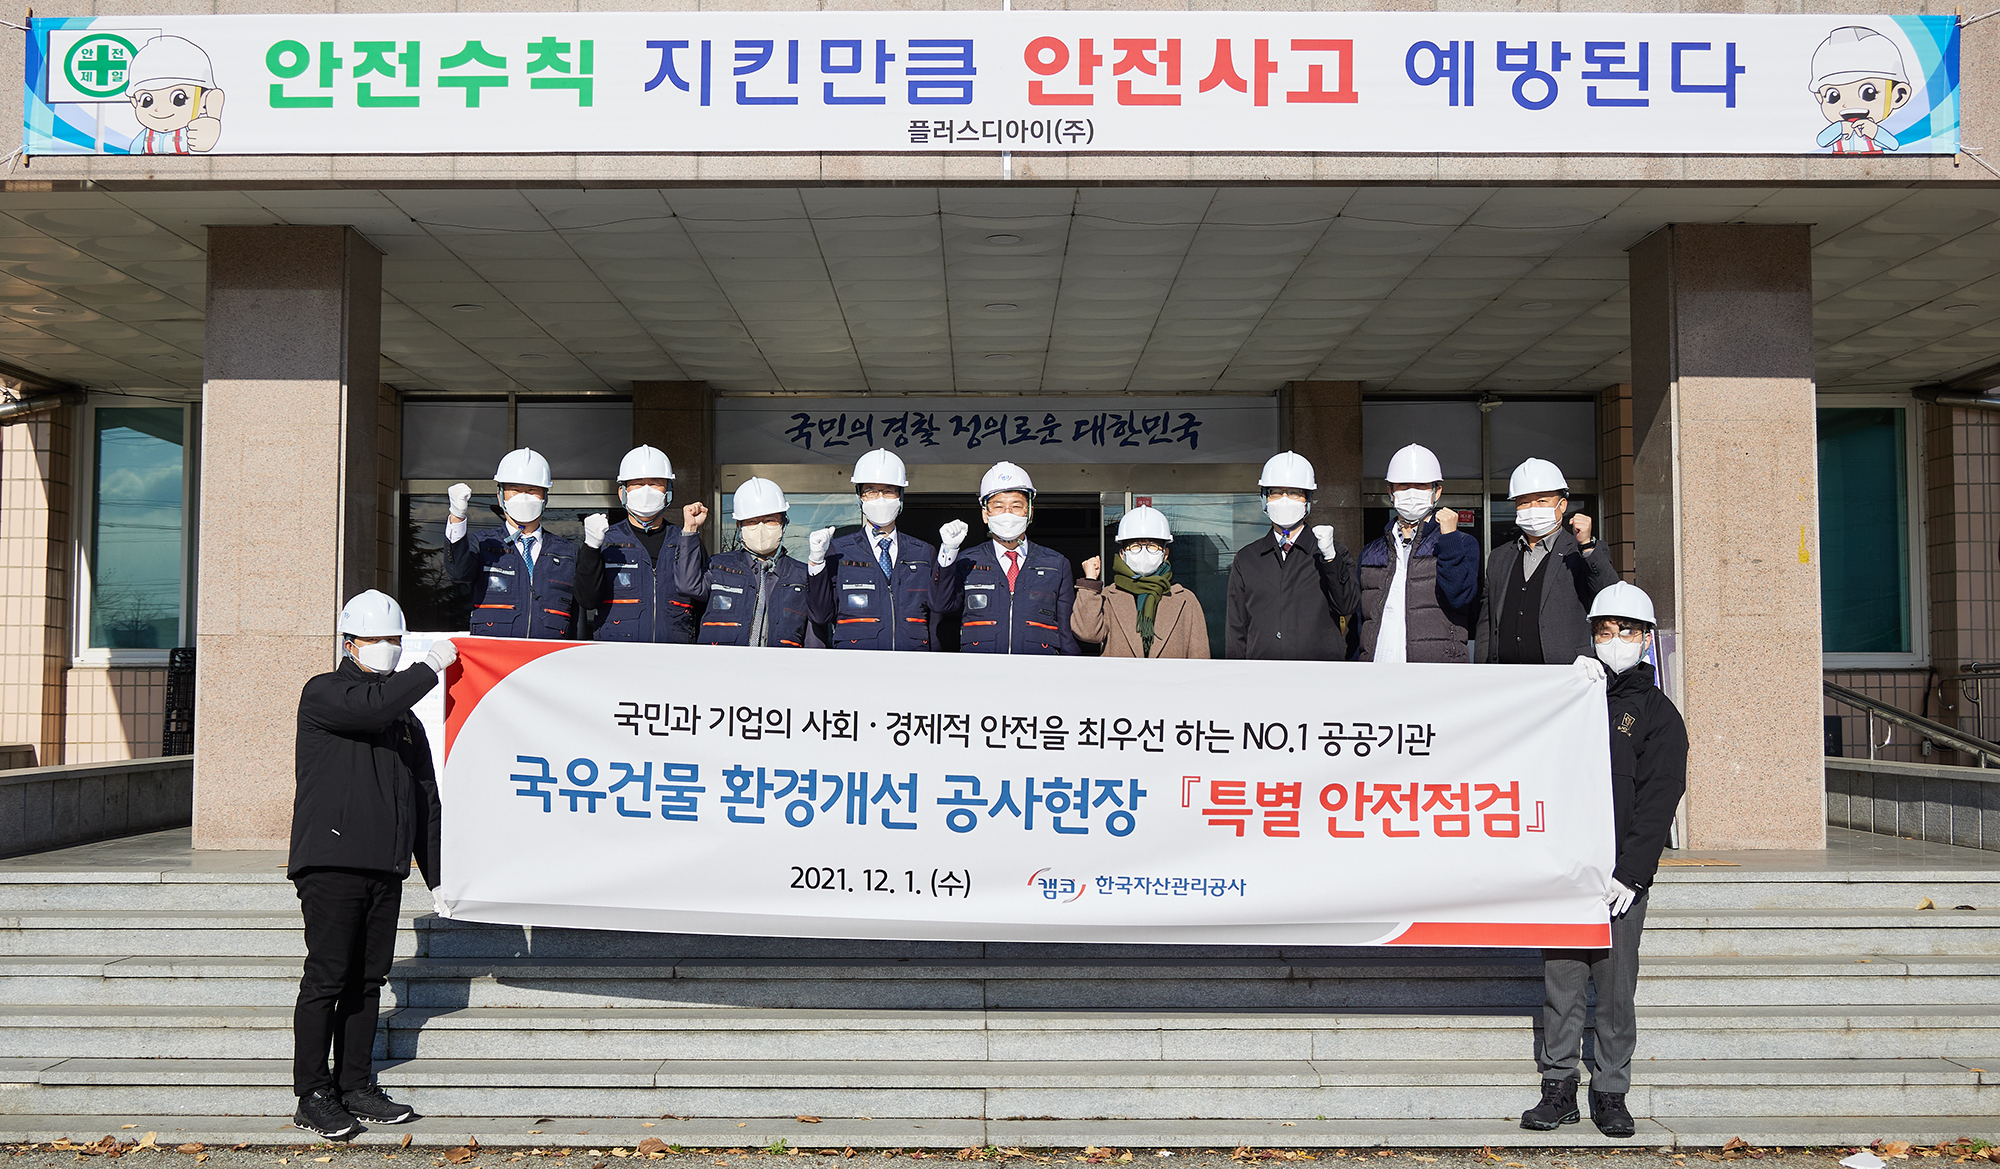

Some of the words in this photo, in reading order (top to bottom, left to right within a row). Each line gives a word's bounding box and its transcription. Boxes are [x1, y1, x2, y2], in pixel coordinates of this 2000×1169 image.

[265, 36, 594, 109] 안전수칙
[644, 39, 977, 107] 지킨만큼
[1023, 35, 1359, 107] 안전사고
[1405, 40, 1746, 111] 예방된다
[907, 118, 1095, 145] 플러스디아이(주)
[784, 412, 875, 450] 국민의
[879, 410, 941, 448] 경찰
[948, 413, 1063, 450] 정의로운
[1071, 409, 1203, 450] 대한민국
[613, 701, 702, 737] 국민과
[709, 705, 792, 740] 기업의
[801, 709, 859, 743] 사회
[886, 712, 970, 748] 경제적
[980, 715, 1070, 751] 안전을
[1076, 717, 1165, 753] 최우선
[1174, 720, 1235, 754] 하는
[1242, 722, 1309, 754] NO.1
[1317, 723, 1436, 758] 공공기관
[510, 755, 707, 822] 국유건물
[720, 764, 918, 830] 환경개선
[936, 774, 1148, 838] 공사현장
[790, 866, 855, 893] 2021.
[863, 869, 895, 894] 12.
[904, 870, 921, 895] 1.
[930, 868, 971, 899] (수)
[1037, 877, 1076, 900] 캠코
[1095, 875, 1247, 898] 한국자산관리공사
